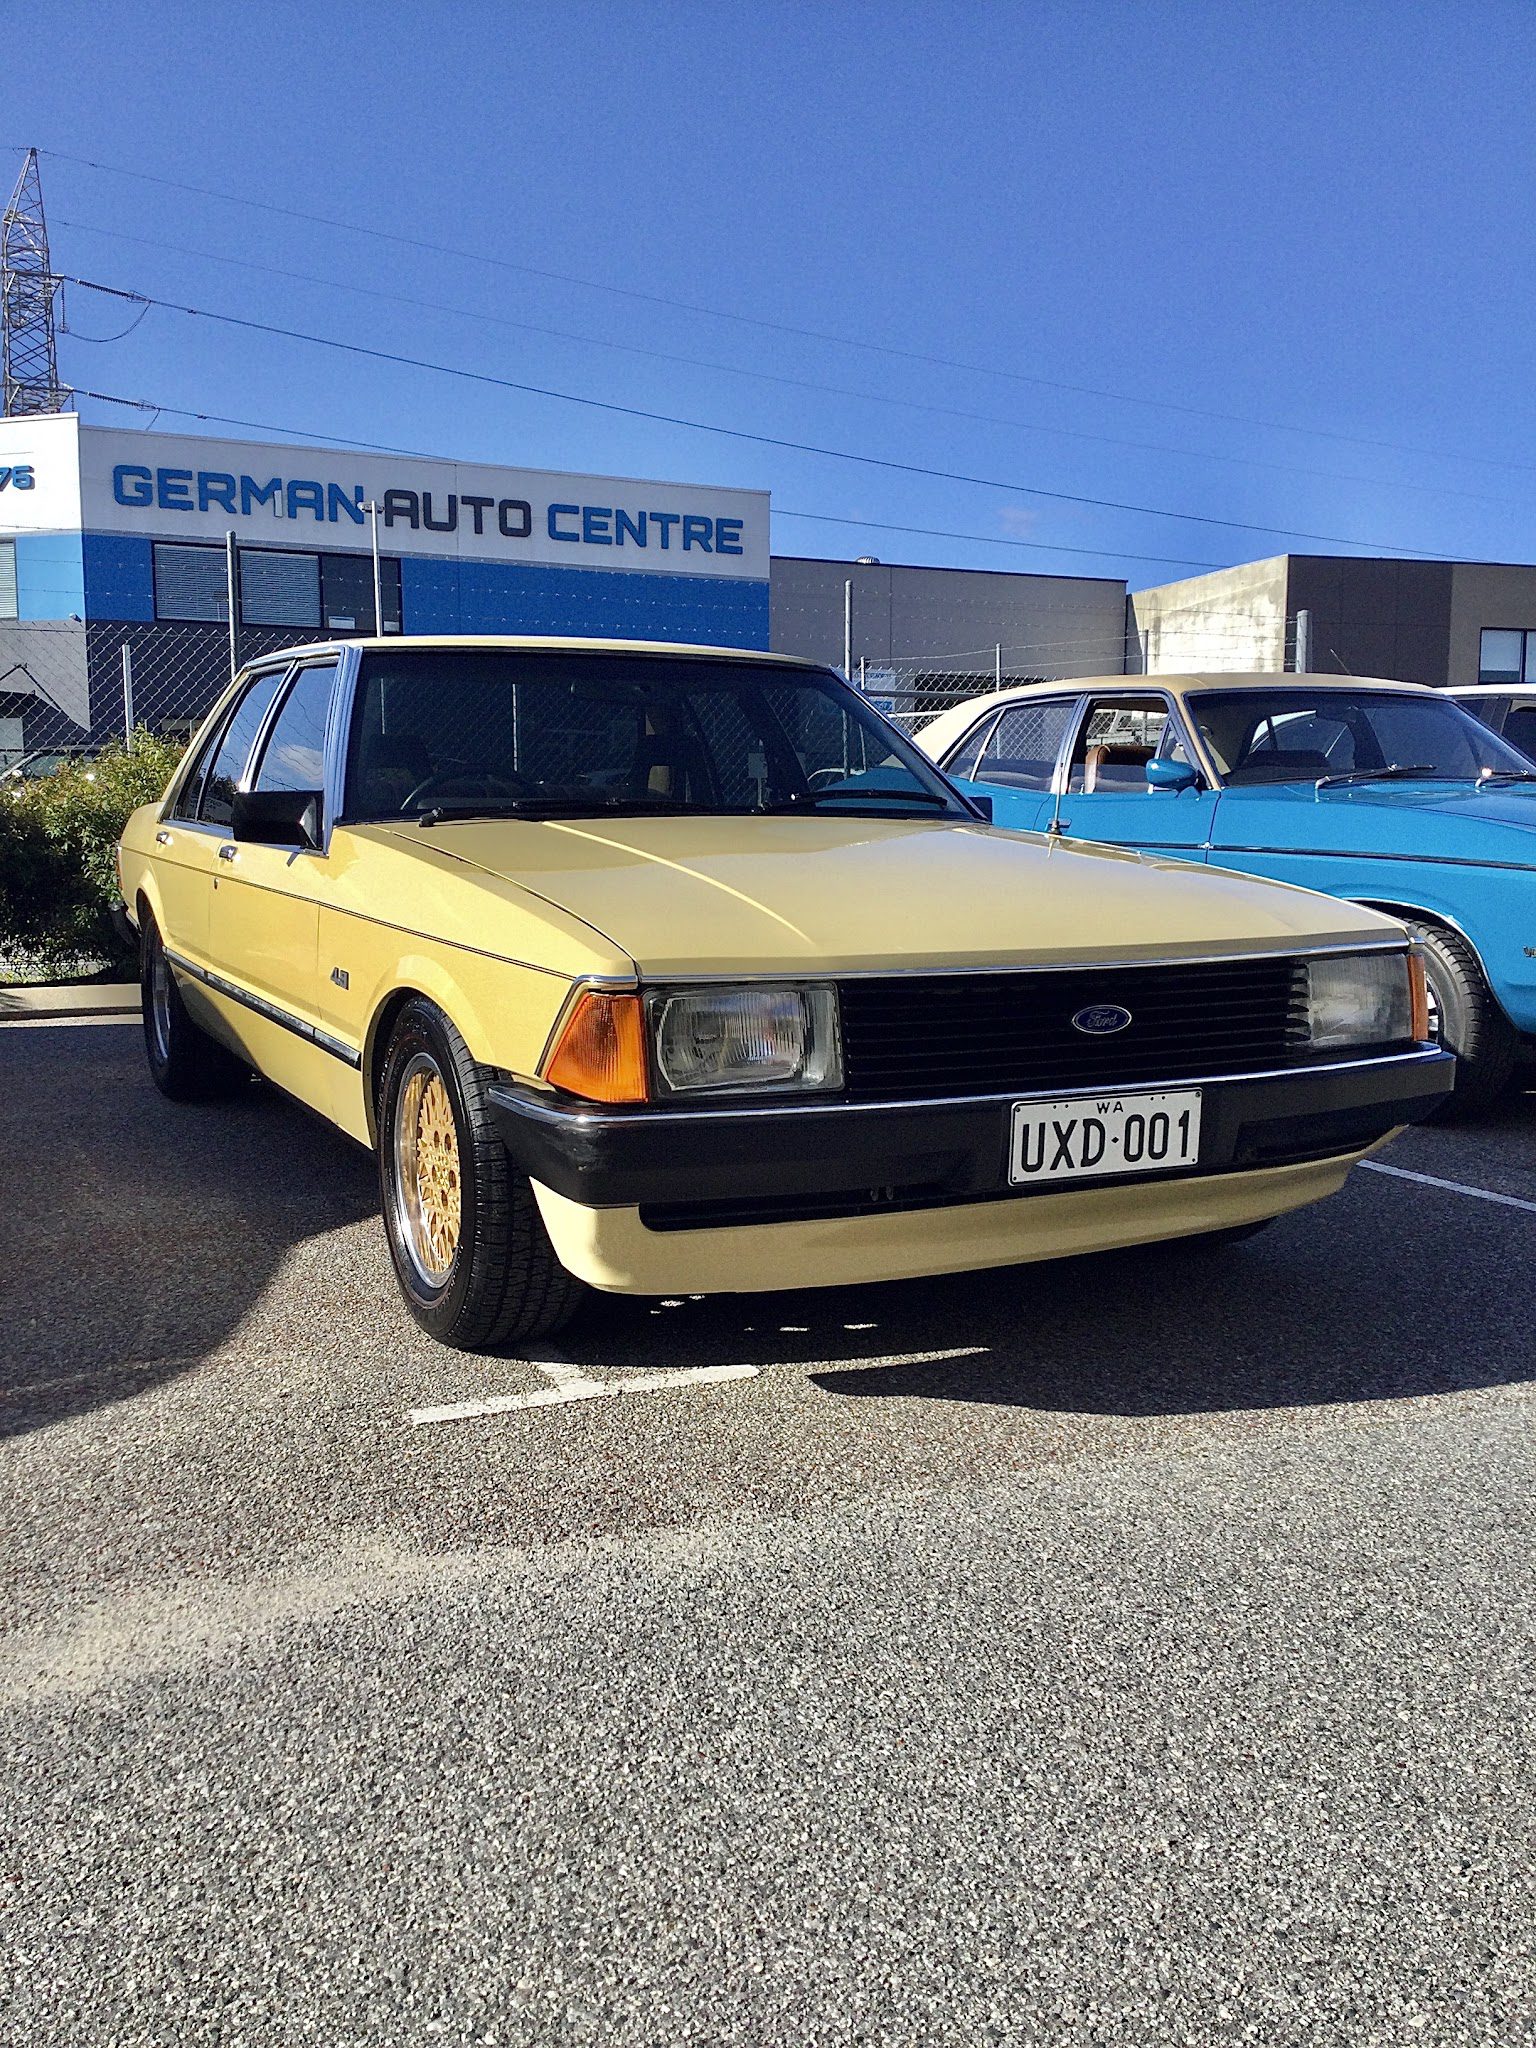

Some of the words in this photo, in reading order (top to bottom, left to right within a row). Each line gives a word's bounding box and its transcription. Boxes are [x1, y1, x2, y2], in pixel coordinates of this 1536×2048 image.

[112, 464, 364, 525] GERMAN
[384, 489, 532, 538] AUTO
[548, 503, 744, 554] CENTRE
[1087, 1010, 1118, 1027] Ford
[1097, 1101, 1124, 1114] WA
